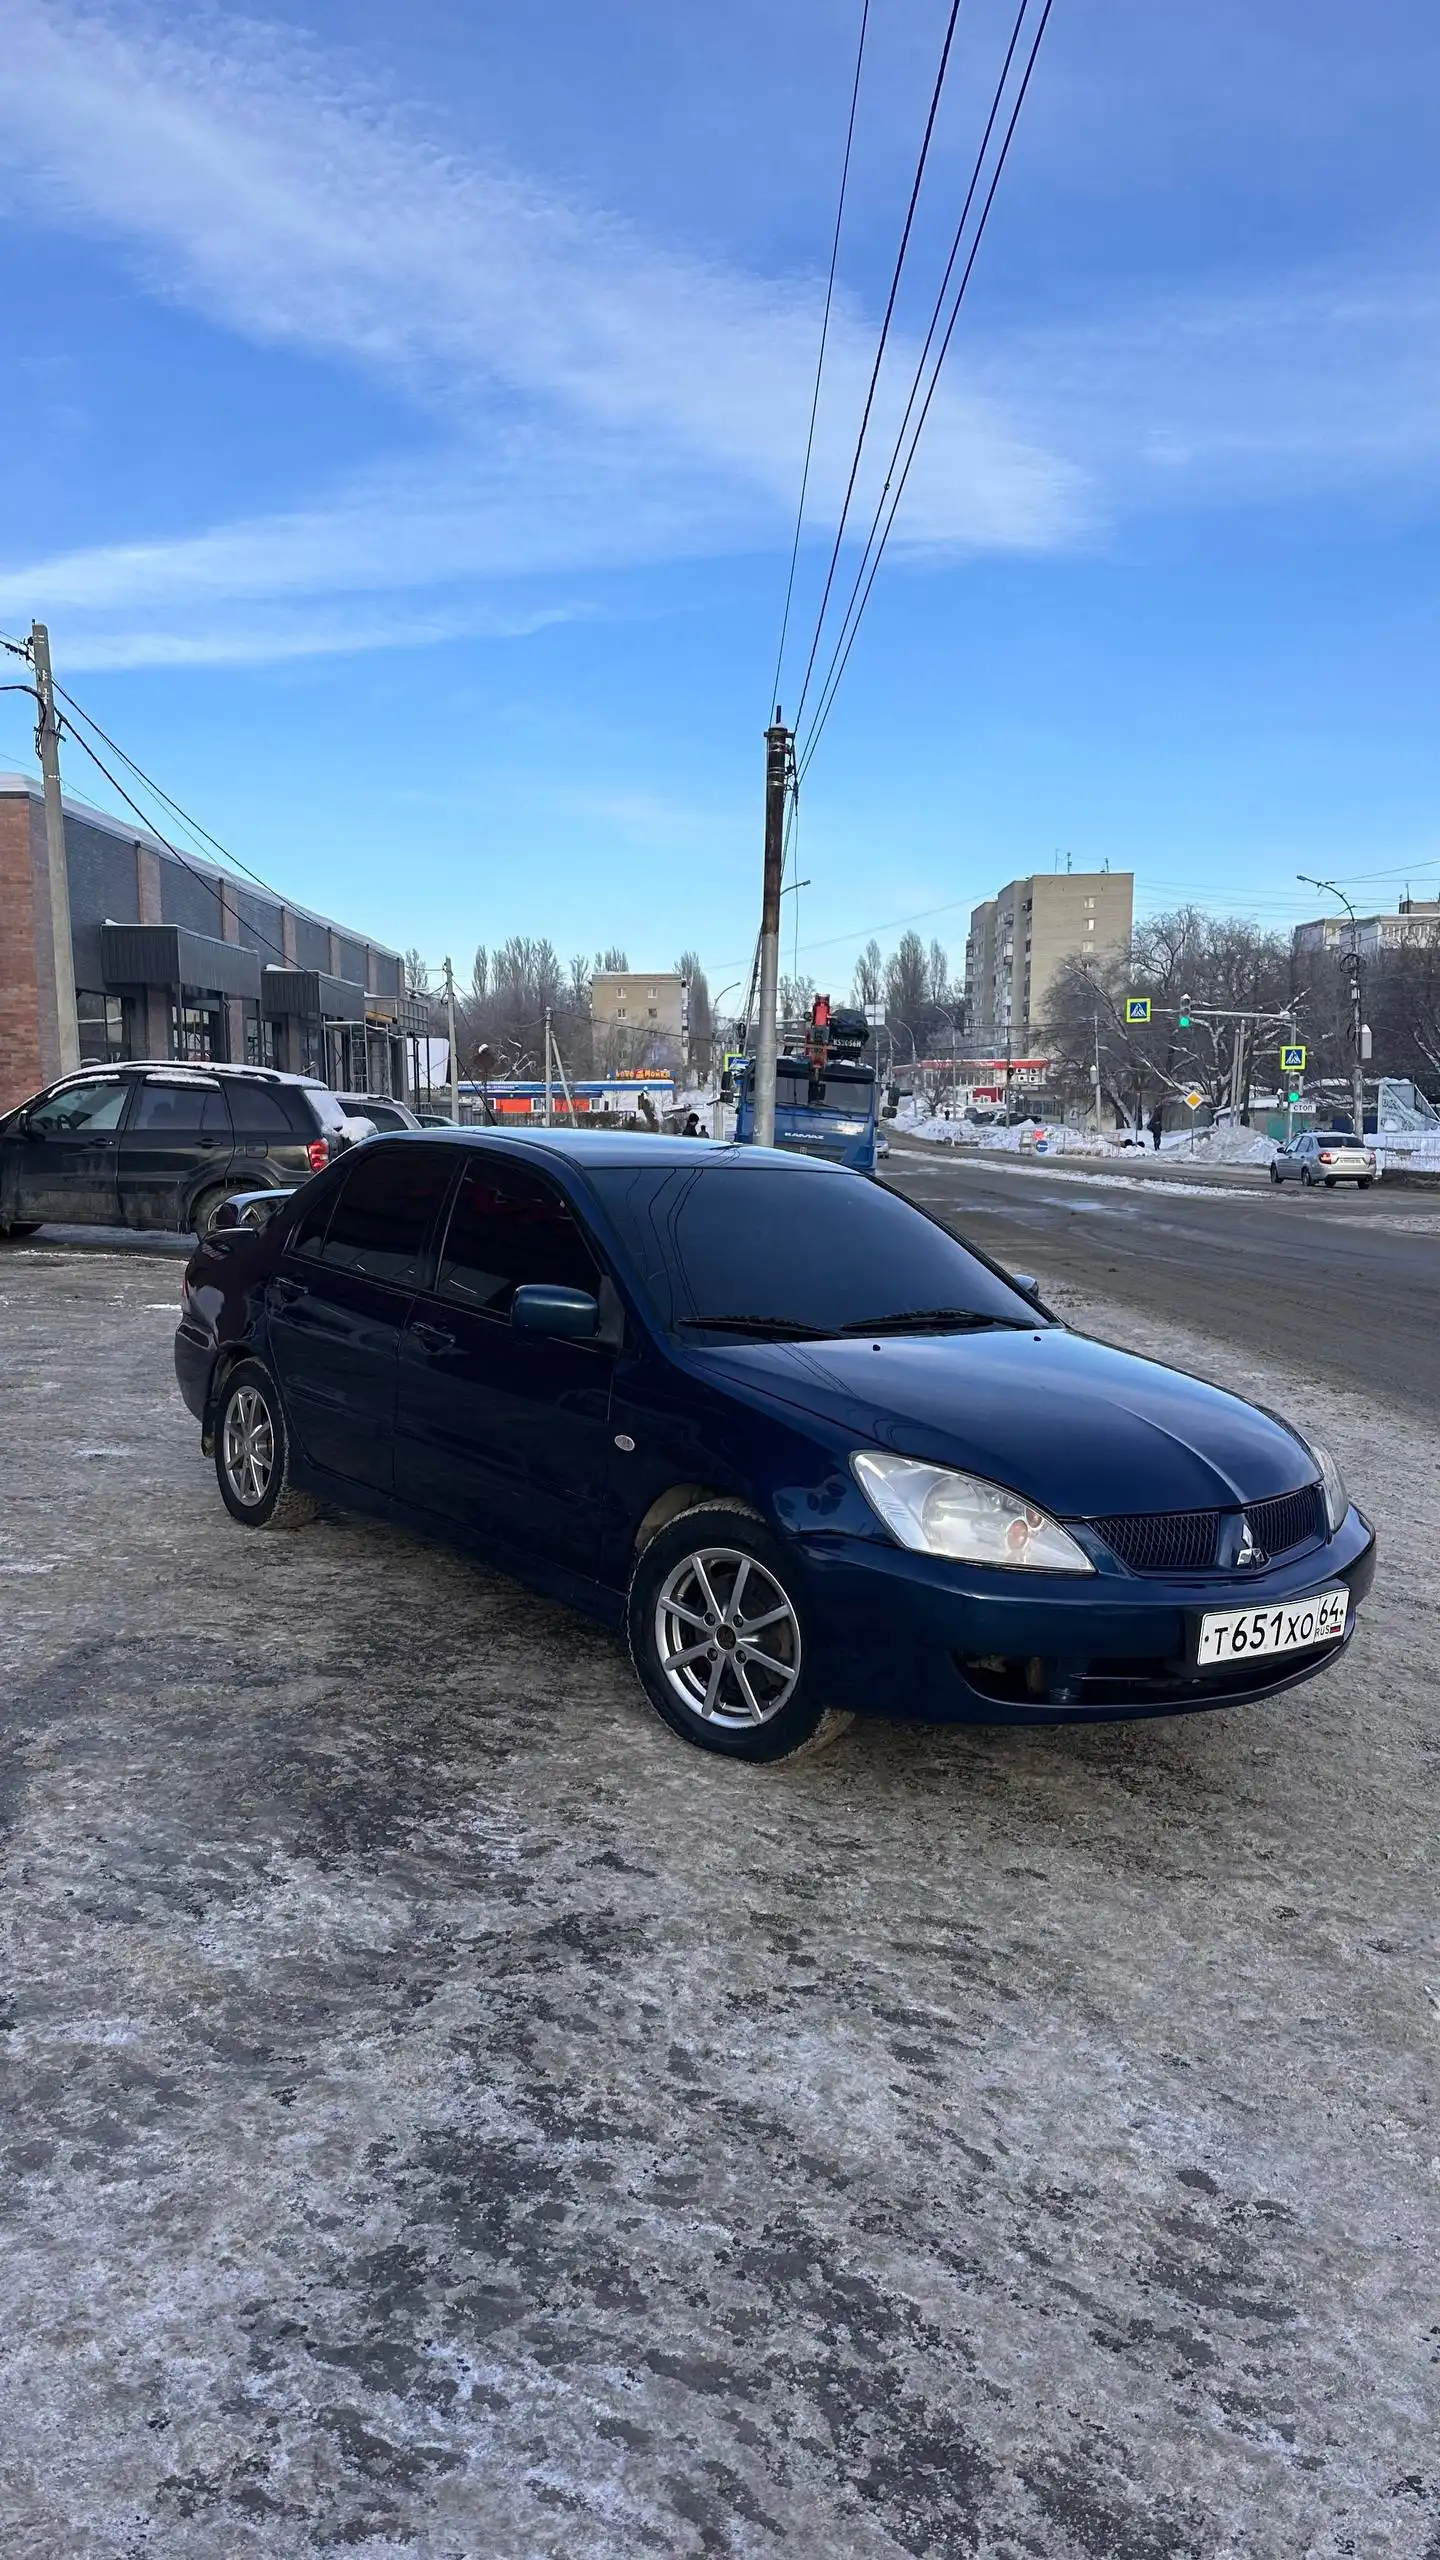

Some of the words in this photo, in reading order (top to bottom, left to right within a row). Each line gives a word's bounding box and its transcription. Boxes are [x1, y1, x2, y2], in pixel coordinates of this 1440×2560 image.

[1293, 1104, 1313, 1112] СТОП
[784, 1132, 825, 1140] KAMAZ
[1214, 1610, 1314, 1656] Т651ХО
[1319, 1596, 1339, 1626] 64
[1315, 1624, 1330, 1636] RUS
